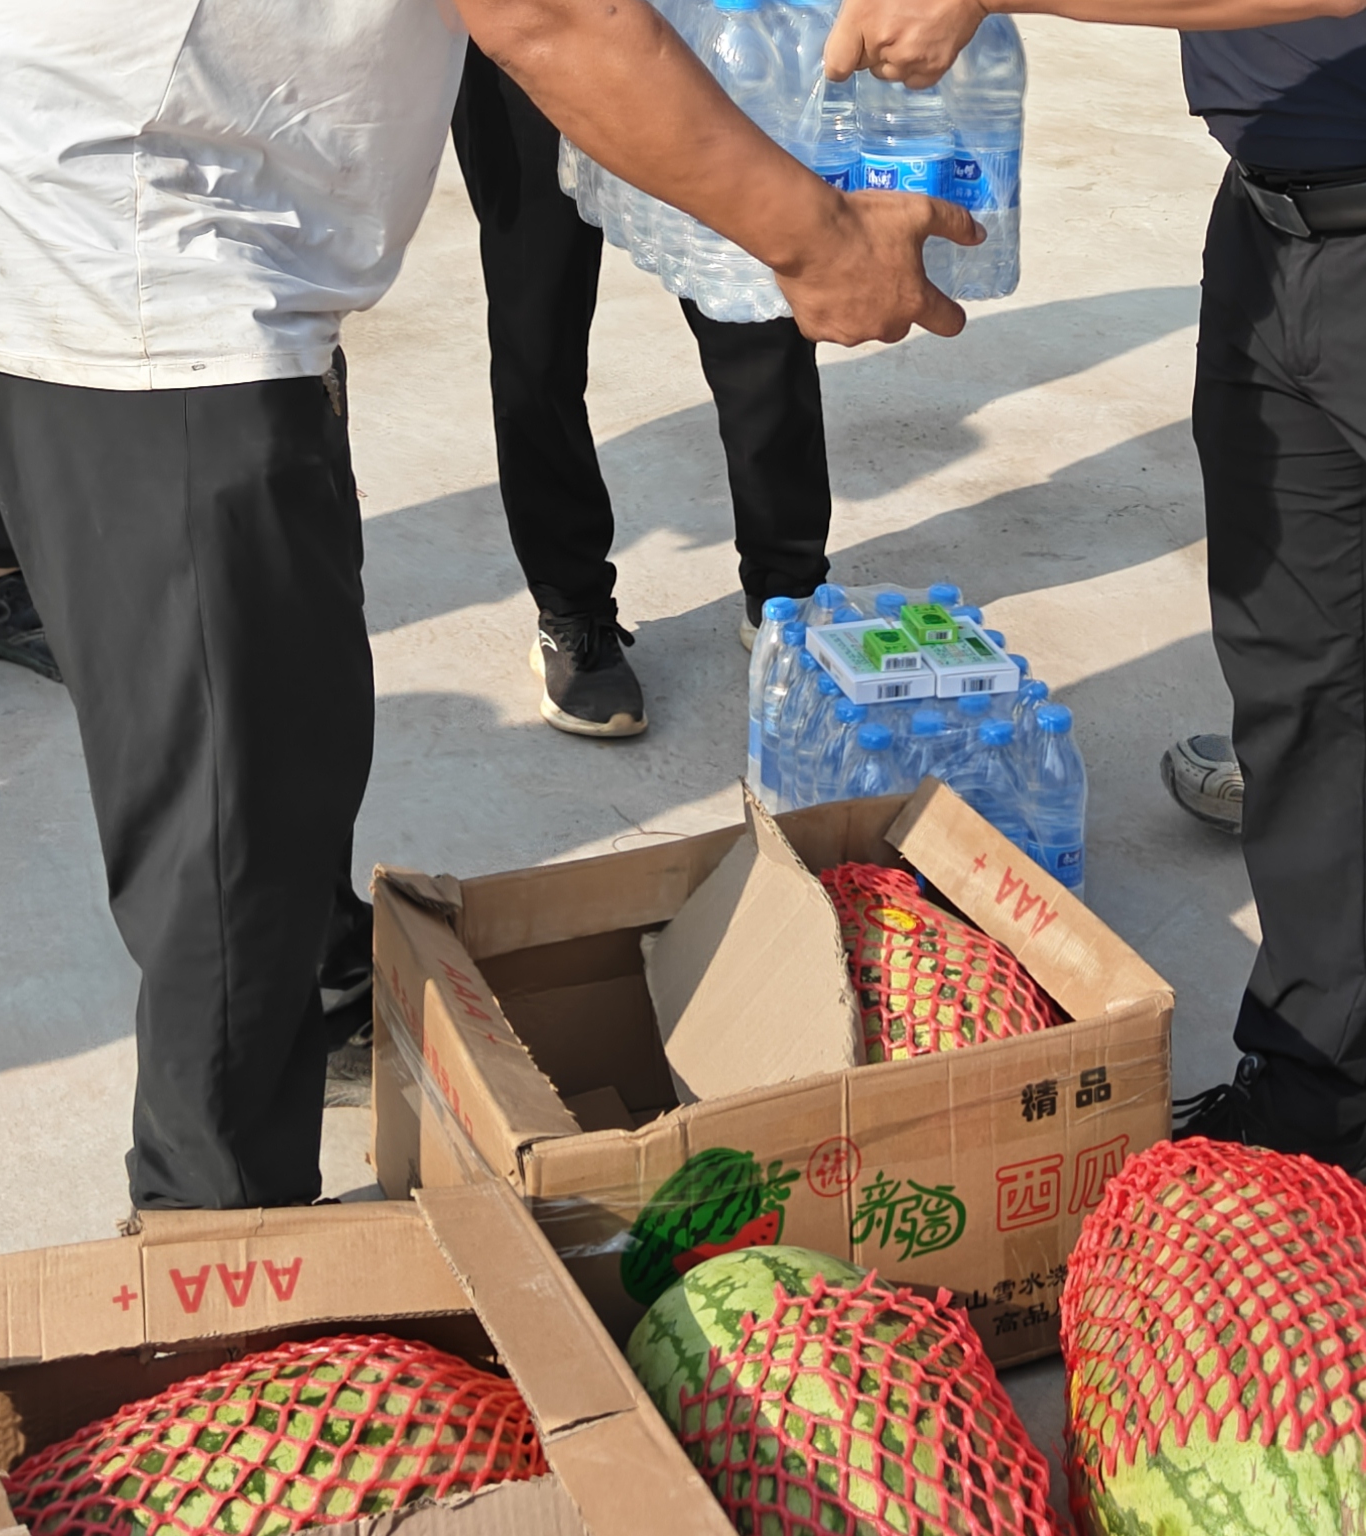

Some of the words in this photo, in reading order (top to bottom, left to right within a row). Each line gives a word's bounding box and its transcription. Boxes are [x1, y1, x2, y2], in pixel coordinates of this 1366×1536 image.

[1021, 1066, 1112, 1122] 精品
[850, 1169, 967, 1262] 新疆
[995, 1133, 1130, 1232] 西瓜
